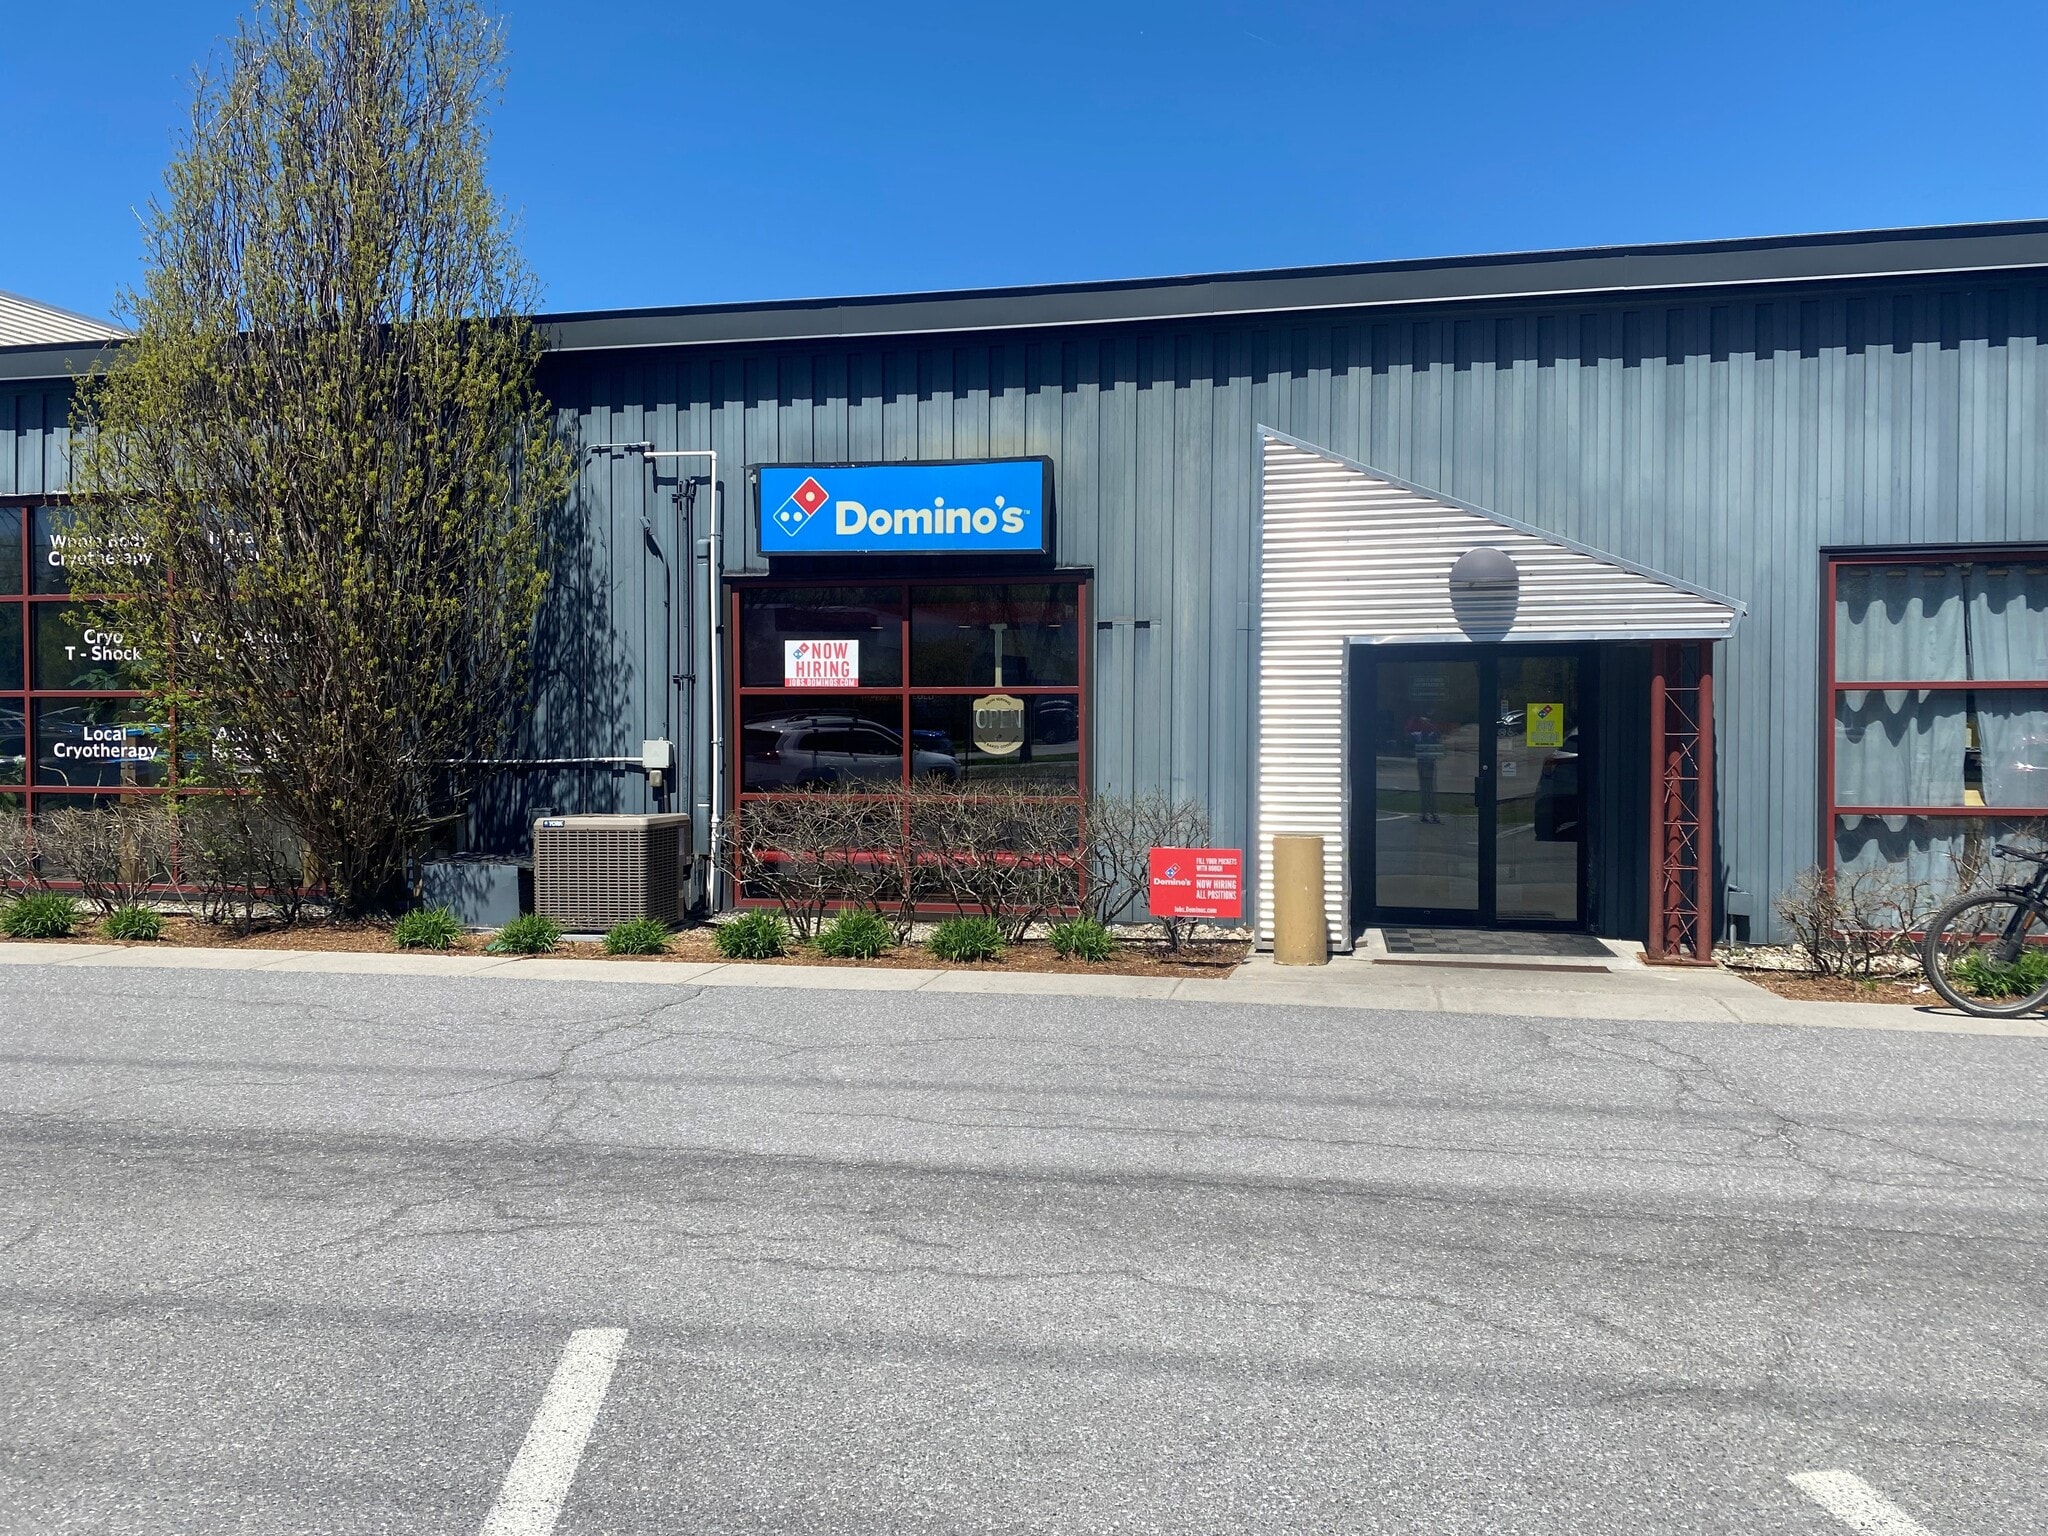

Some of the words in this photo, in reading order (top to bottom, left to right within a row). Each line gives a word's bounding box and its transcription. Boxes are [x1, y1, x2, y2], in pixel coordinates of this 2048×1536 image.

[836, 496, 1024, 536] Domino's
[48, 551, 153, 566] Cryotheapy
[83, 629, 124, 646] Cryo
[64, 646, 76, 661] T
[91, 646, 142, 661] Shock
[812, 643, 848, 659] NOW
[796, 661, 850, 678] HIRING
[976, 709, 1021, 729] OPEN
[83, 726, 127, 741] Local
[53, 742, 158, 761] Cryotherapy
[1153, 878, 1191, 886] Domino's
[1196, 879, 1212, 889] NOW
[1213, 880, 1237, 890] HIRING
[1196, 890, 1206, 900] ALL
[1207, 890, 1237, 900] POSITIONS
